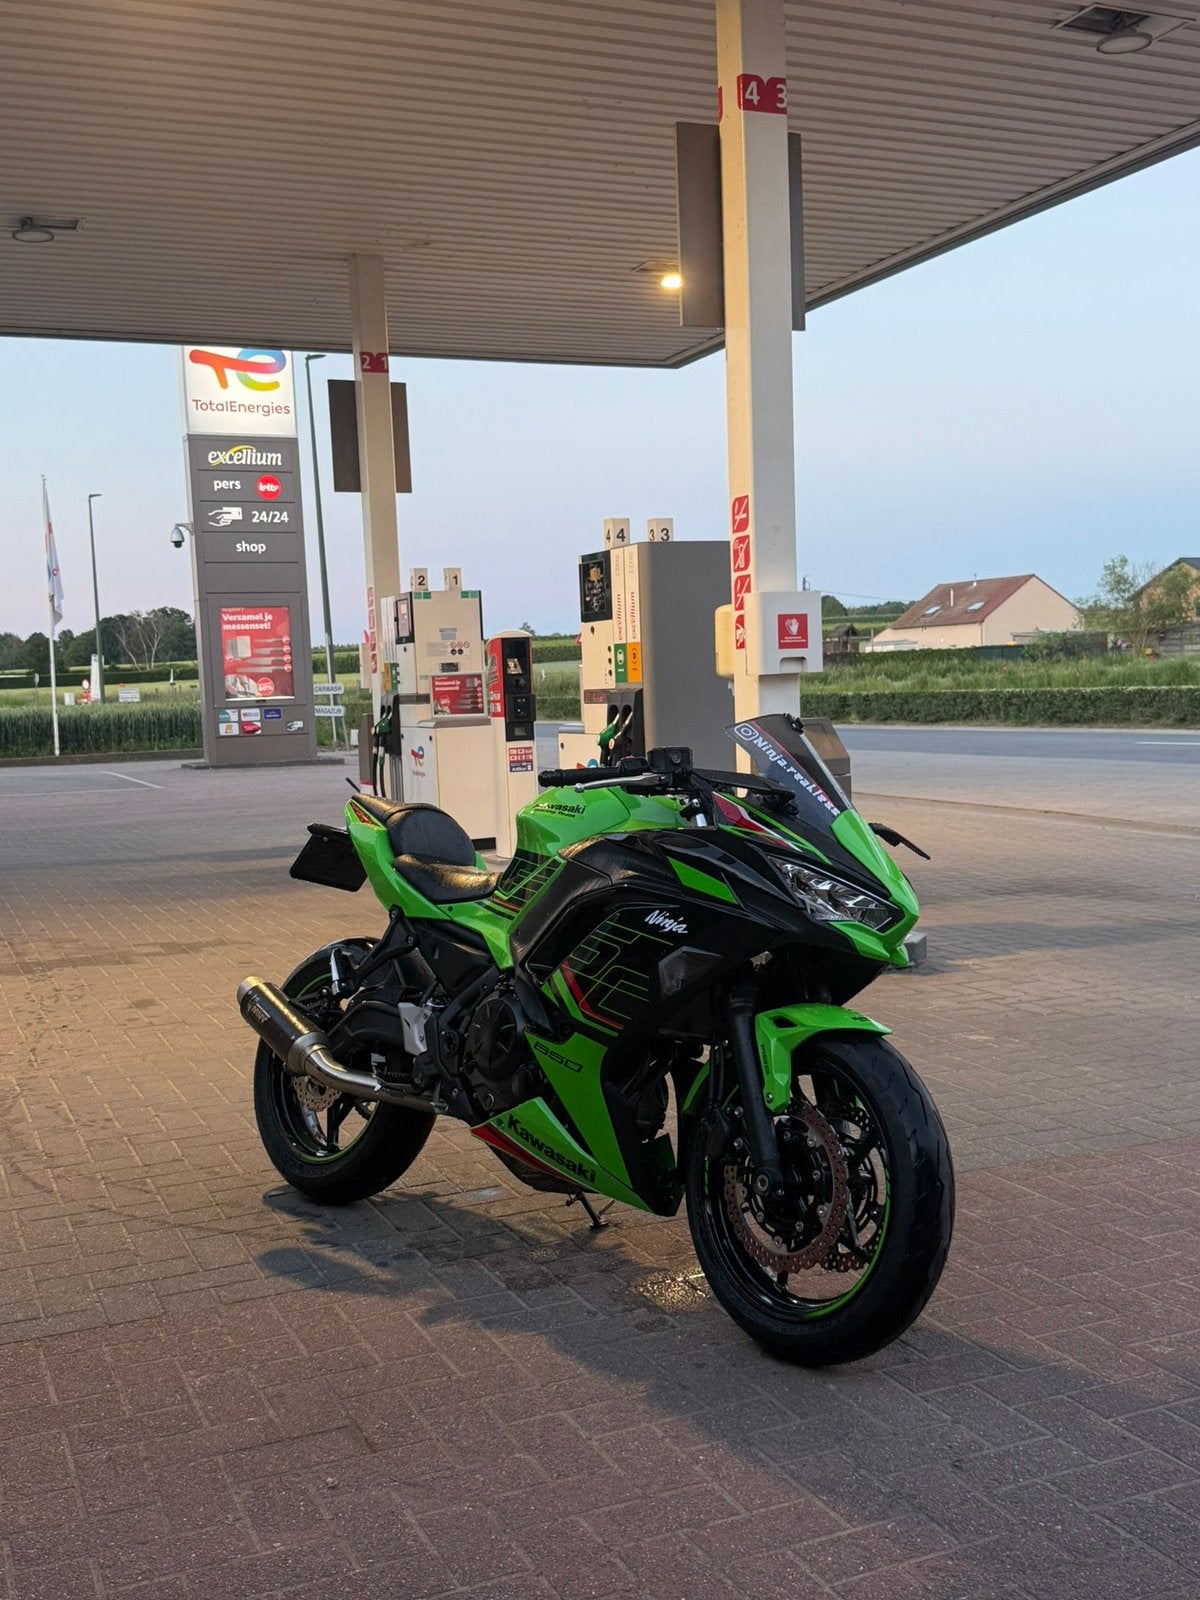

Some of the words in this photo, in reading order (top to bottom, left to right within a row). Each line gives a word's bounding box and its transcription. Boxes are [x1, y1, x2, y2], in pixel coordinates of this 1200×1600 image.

[744, 80, 760, 106] 4
[776, 83, 787, 109] 3
[361, 355, 371, 369] 2
[380, 356, 388, 370] 1
[192, 399, 291, 417] TotalEnergies
[208, 447, 282, 466] excellium
[213, 479, 241, 492] pers
[251, 510, 289, 523] 24/24
[616, 528, 626, 542] 4
[660, 528, 670, 542] 3
[235, 540, 266, 554] shop
[418, 575, 425, 586] 2
[453, 574, 458, 585] 1
[644, 909, 688, 934] Ninja
[533, 1041, 583, 1073] 650
[508, 1114, 597, 1184] Kawasaki
